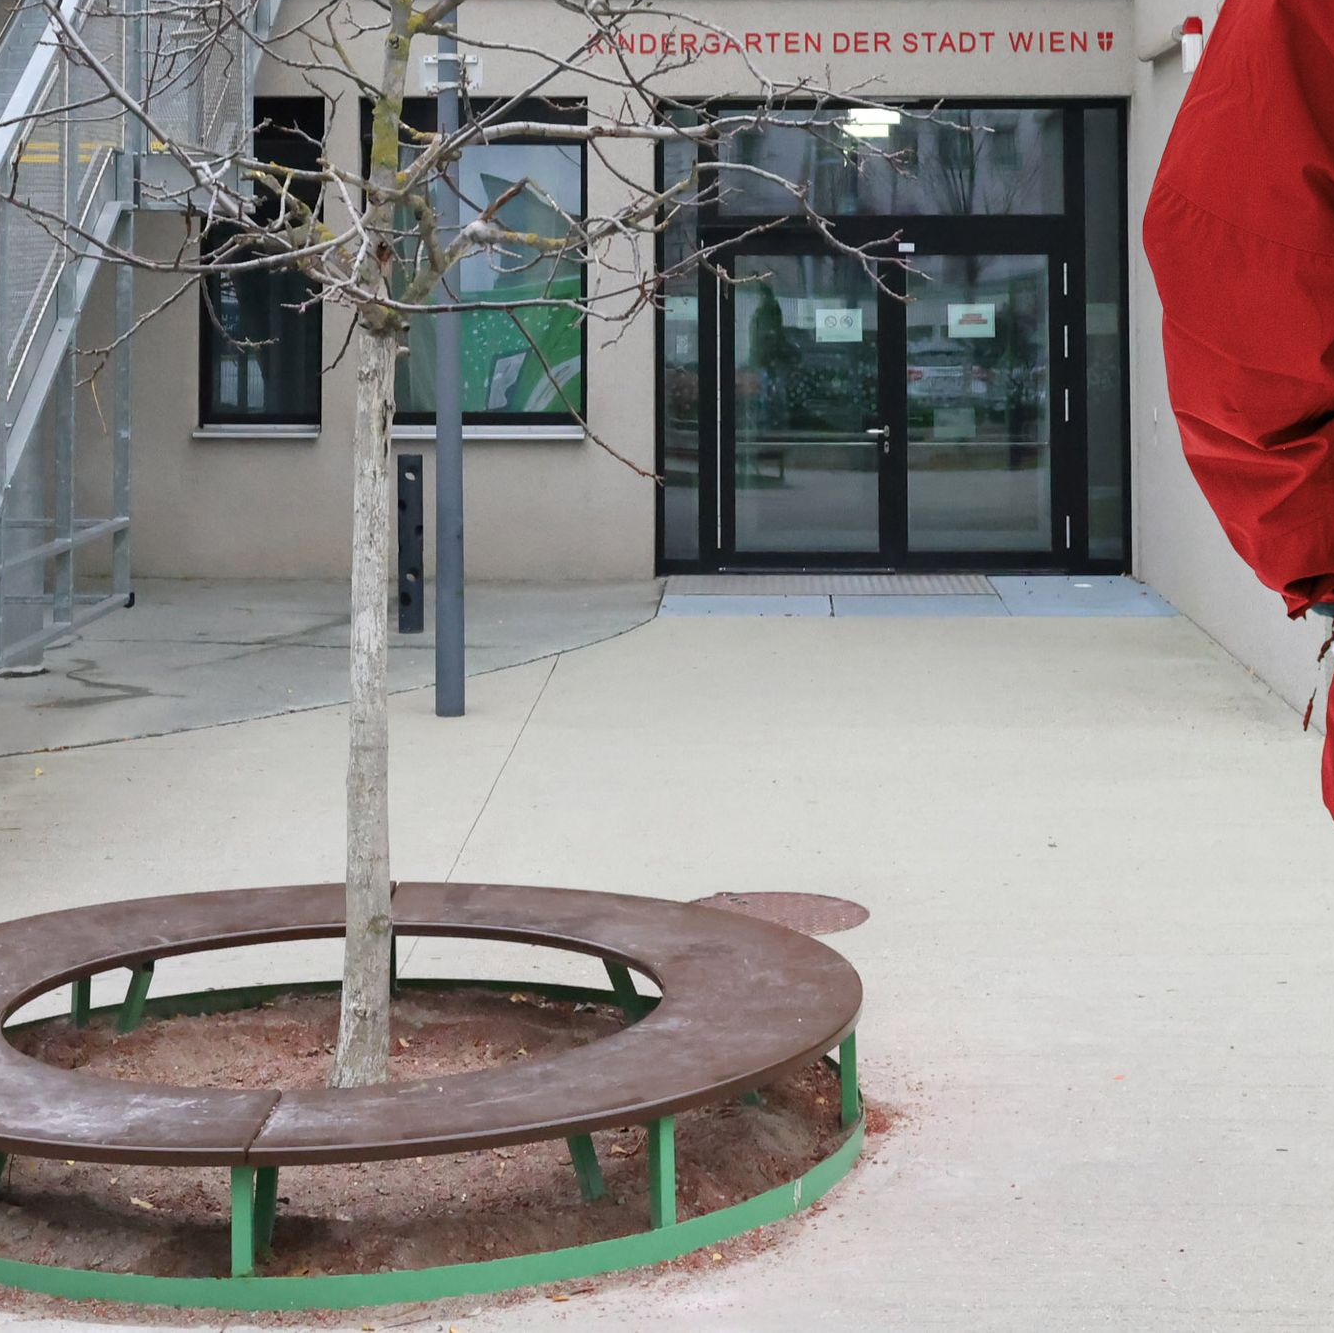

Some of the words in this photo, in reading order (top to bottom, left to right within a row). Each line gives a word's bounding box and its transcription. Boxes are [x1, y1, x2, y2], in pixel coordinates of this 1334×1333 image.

[832, 30, 892, 54] DER
[901, 30, 996, 54] STADT
[1008, 30, 1090, 54] WIEN
